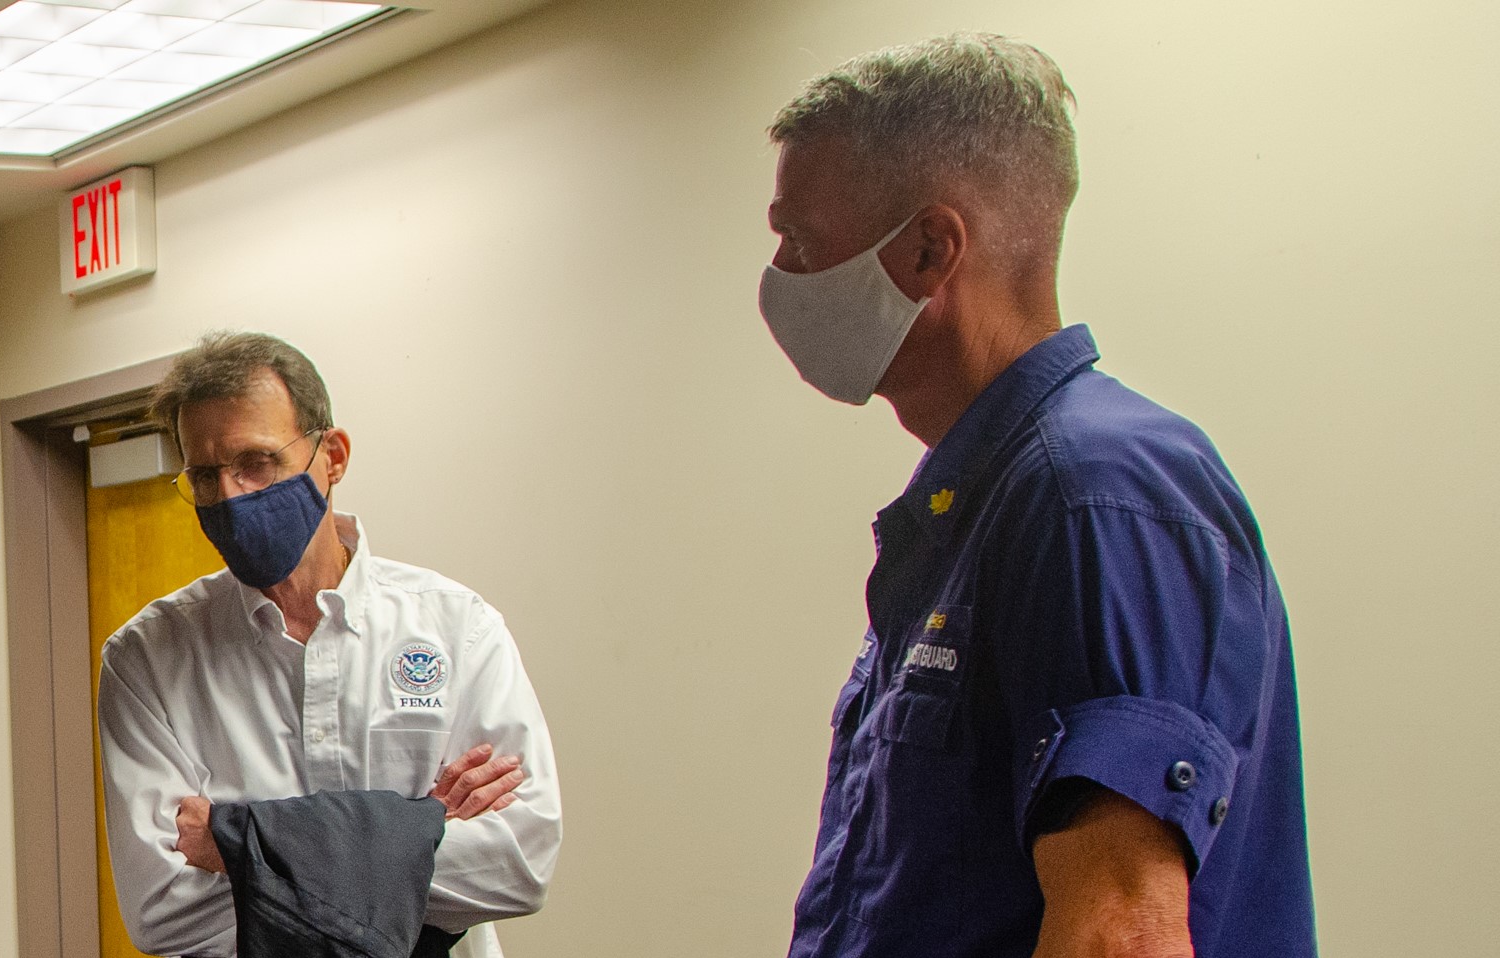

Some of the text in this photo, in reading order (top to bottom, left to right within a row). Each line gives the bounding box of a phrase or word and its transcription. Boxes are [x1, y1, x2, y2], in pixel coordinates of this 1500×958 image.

[72, 179, 122, 279] EXIT
[920, 644, 957, 672] GUARD
[400, 697, 443, 708] FEMA
